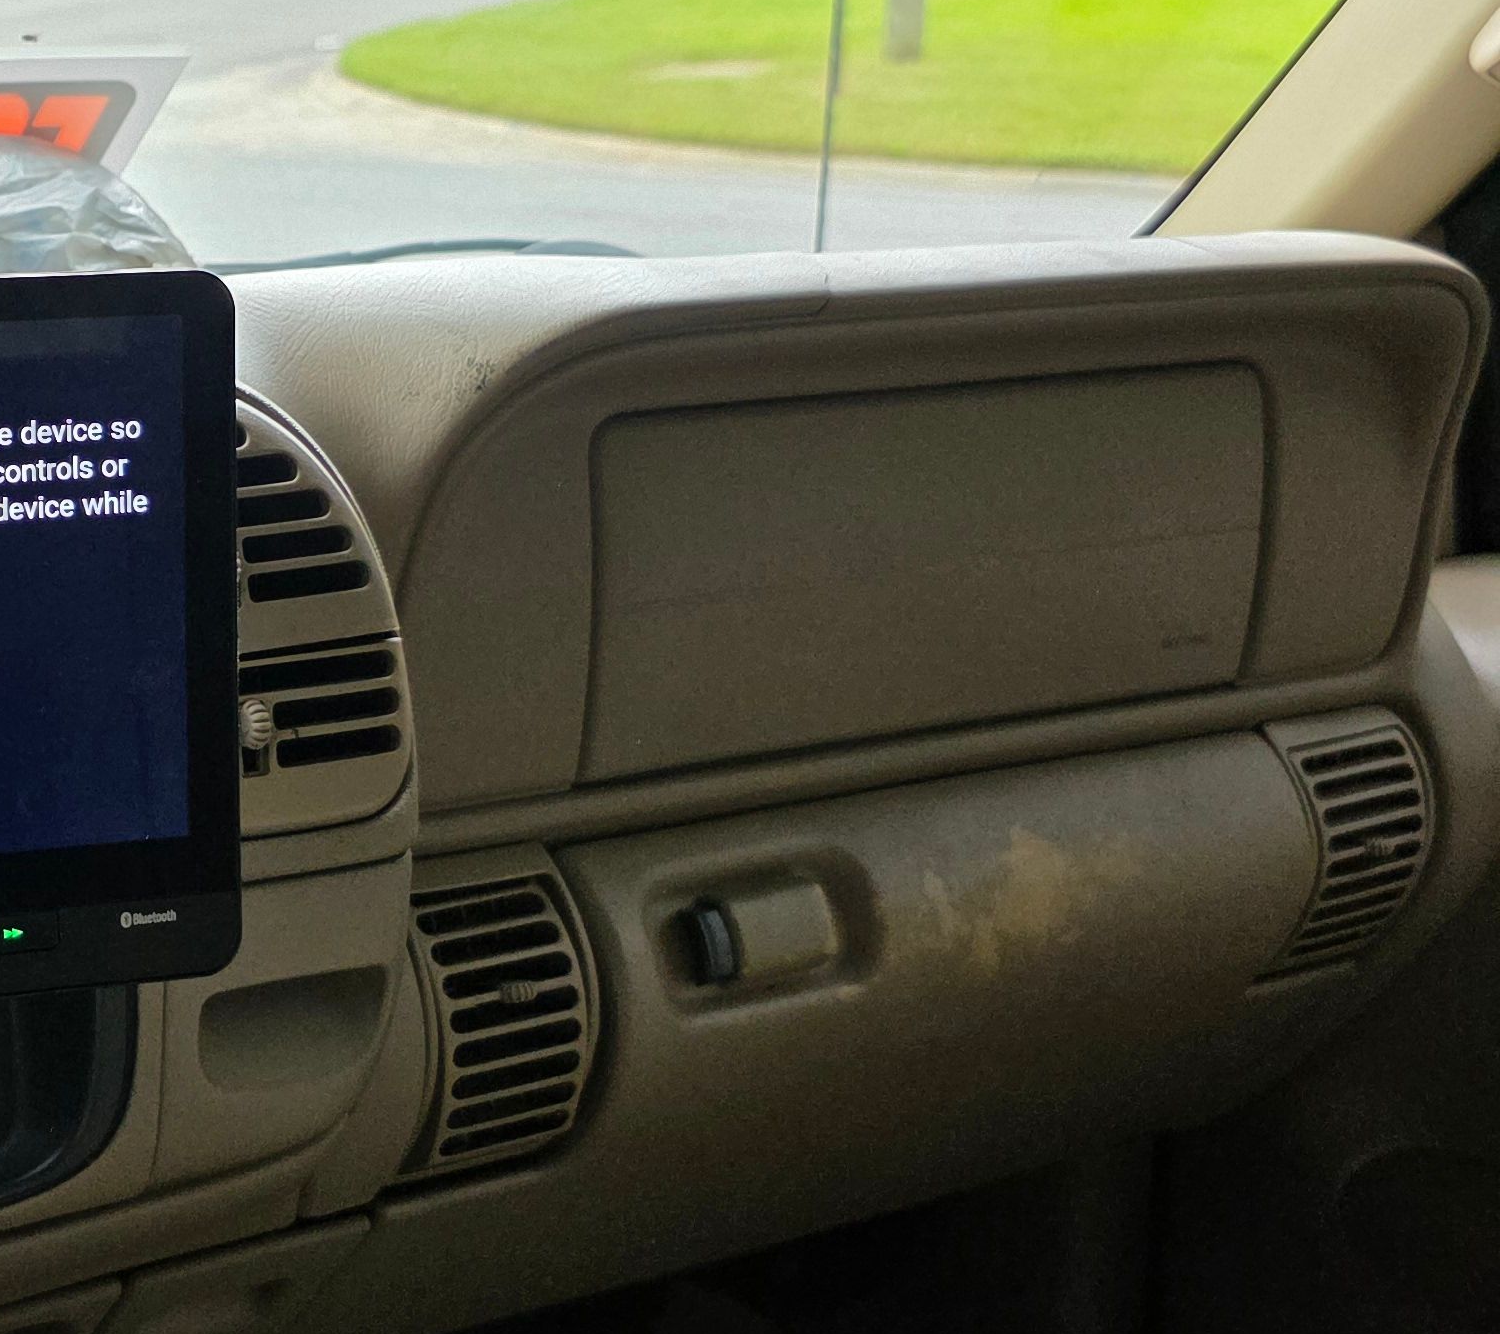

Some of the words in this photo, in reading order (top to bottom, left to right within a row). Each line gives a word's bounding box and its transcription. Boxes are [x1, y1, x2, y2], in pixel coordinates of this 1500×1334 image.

[20, 418, 104, 445] device
[110, 420, 142, 440] so
[101, 458, 130, 478] or
[81, 489, 150, 517] while
[133, 908, 177, 926] Bluetooth
